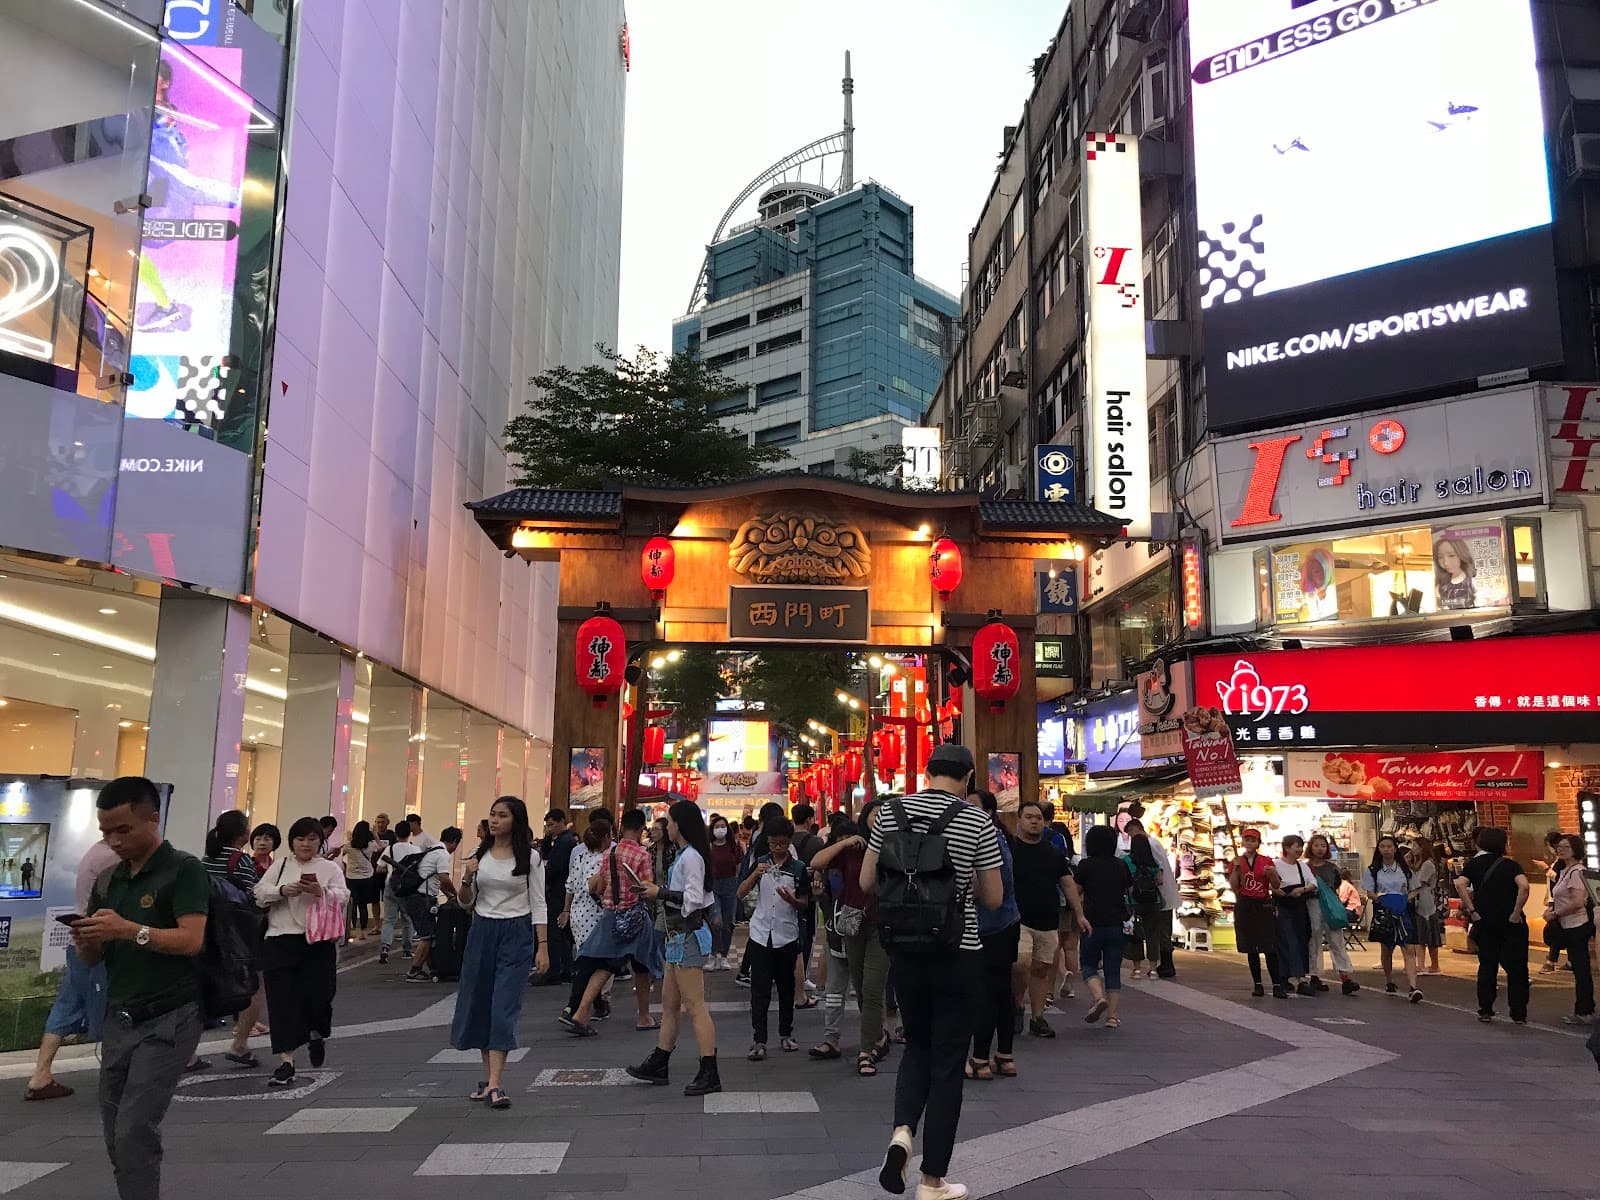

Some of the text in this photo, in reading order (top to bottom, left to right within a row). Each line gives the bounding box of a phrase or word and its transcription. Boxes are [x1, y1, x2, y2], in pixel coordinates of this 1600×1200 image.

[1209, 0, 1383, 79] ENDLESS GO
[1226, 287, 1528, 370] NIKE.COM/SPORTSWEAR
[1106, 390, 1133, 510] hair salon
[1356, 465, 1532, 510] hair salon
[749, 600, 852, 629] 西門町
[588, 635, 612, 681] 神都
[991, 642, 1013, 687] 神都
[1239, 683, 1310, 722] 1973
[1185, 735, 1228, 750] Taiwan
[1196, 742, 1230, 761] No.1
[1294, 779, 1321, 789] CNN
[1377, 753, 1524, 777] Taiwan No.1
[1396, 778, 1472, 788] Fried chicken!!
